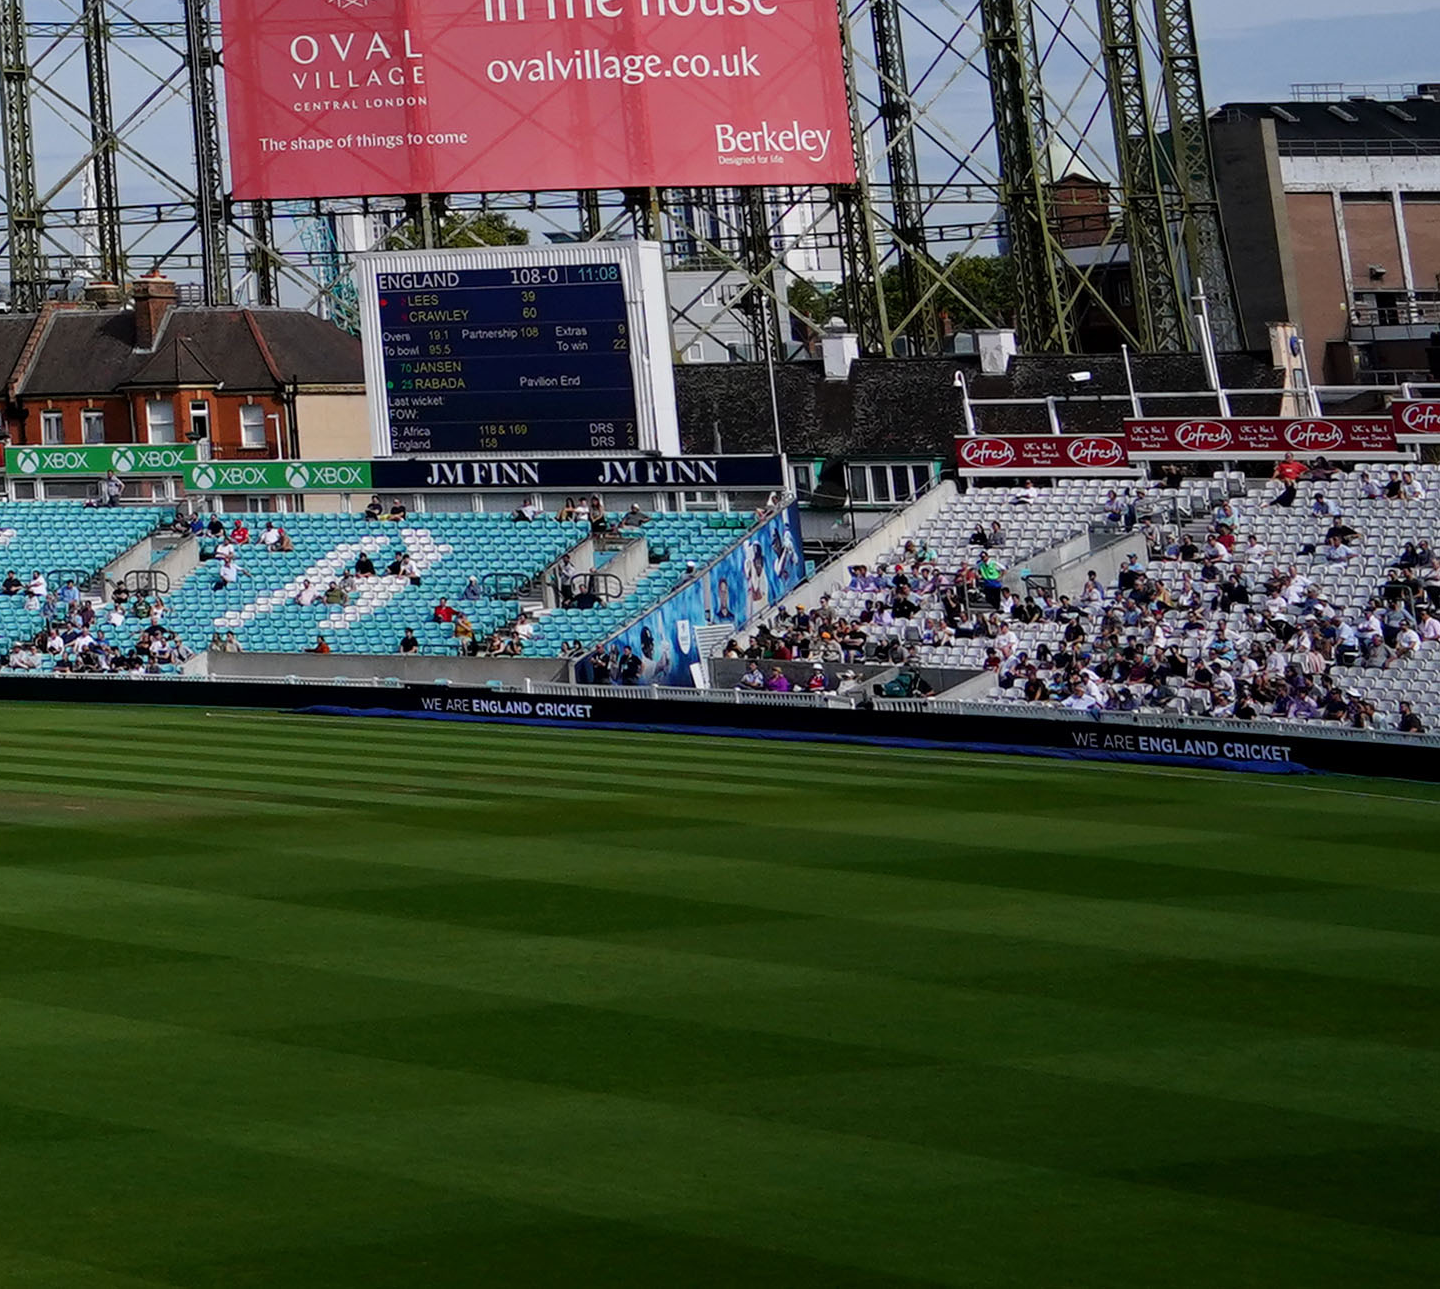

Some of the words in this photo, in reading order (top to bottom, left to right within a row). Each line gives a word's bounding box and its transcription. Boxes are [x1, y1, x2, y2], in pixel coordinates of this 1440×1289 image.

[290, 29, 423, 65] OVAL
[487, 46, 761, 84] ovalvillage.co.uk
[292, 66, 425, 90] VILLAGE
[294, 100, 358, 112] CENTRAL
[365, 96, 428, 109] LONDON
[259, 138, 286, 151] The
[291, 137, 332, 151] shape
[337, 135, 354, 148] of
[357, 134, 403, 149] things
[407, 134, 422, 146] to
[427, 132, 467, 145] come
[715, 121, 831, 162] Berkeley
[758, 155, 769, 164] for
[378, 272, 459, 289] ENGLAND
[510, 268, 558, 284] 108-0
[578, 266, 618, 281] 11:08
[407, 295, 439, 306] LEES
[521, 291, 536, 302] 39
[409, 310, 469, 322] CRAWLEY
[523, 307, 537, 318] 60
[383, 332, 410, 341] Overs
[461, 328, 518, 341] Partnership
[520, 327, 539, 337] 108
[556, 326, 588, 336] Extras
[384, 346, 395, 356] To
[556, 341, 569, 351] To
[571, 341, 588, 350] win
[413, 361, 462, 373] JANSEN
[415, 378, 466, 389] RABADA
[520, 376, 558, 386] Pavilion
[561, 375, 581, 386] End
[388, 396, 409, 407] Last
[403, 427, 431, 436] Africa
[589, 423, 614, 433] DRS
[1178, 424, 1229, 446] Cofresh
[1286, 424, 1339, 446] Cofresh
[392, 439, 431, 451] England
[591, 436, 616, 447] DRS
[962, 441, 1012, 463] Cofresh
[1069, 441, 1121, 462] Cofresh
[42, 453, 88, 469] XBOX
[219, 468, 266, 484] XBOX
[312, 467, 362, 484] XBOX
[427, 463, 467, 485] JM
[471, 462, 540, 484] FINN
[598, 462, 638, 484] JM
[644, 460, 719, 484] FINN
[1072, 732, 1098, 748] WE
[1103, 734, 1135, 750] ARE
[1139, 736, 1219, 757] ENGLAND
[1223, 743, 1291, 762] CRICKET
